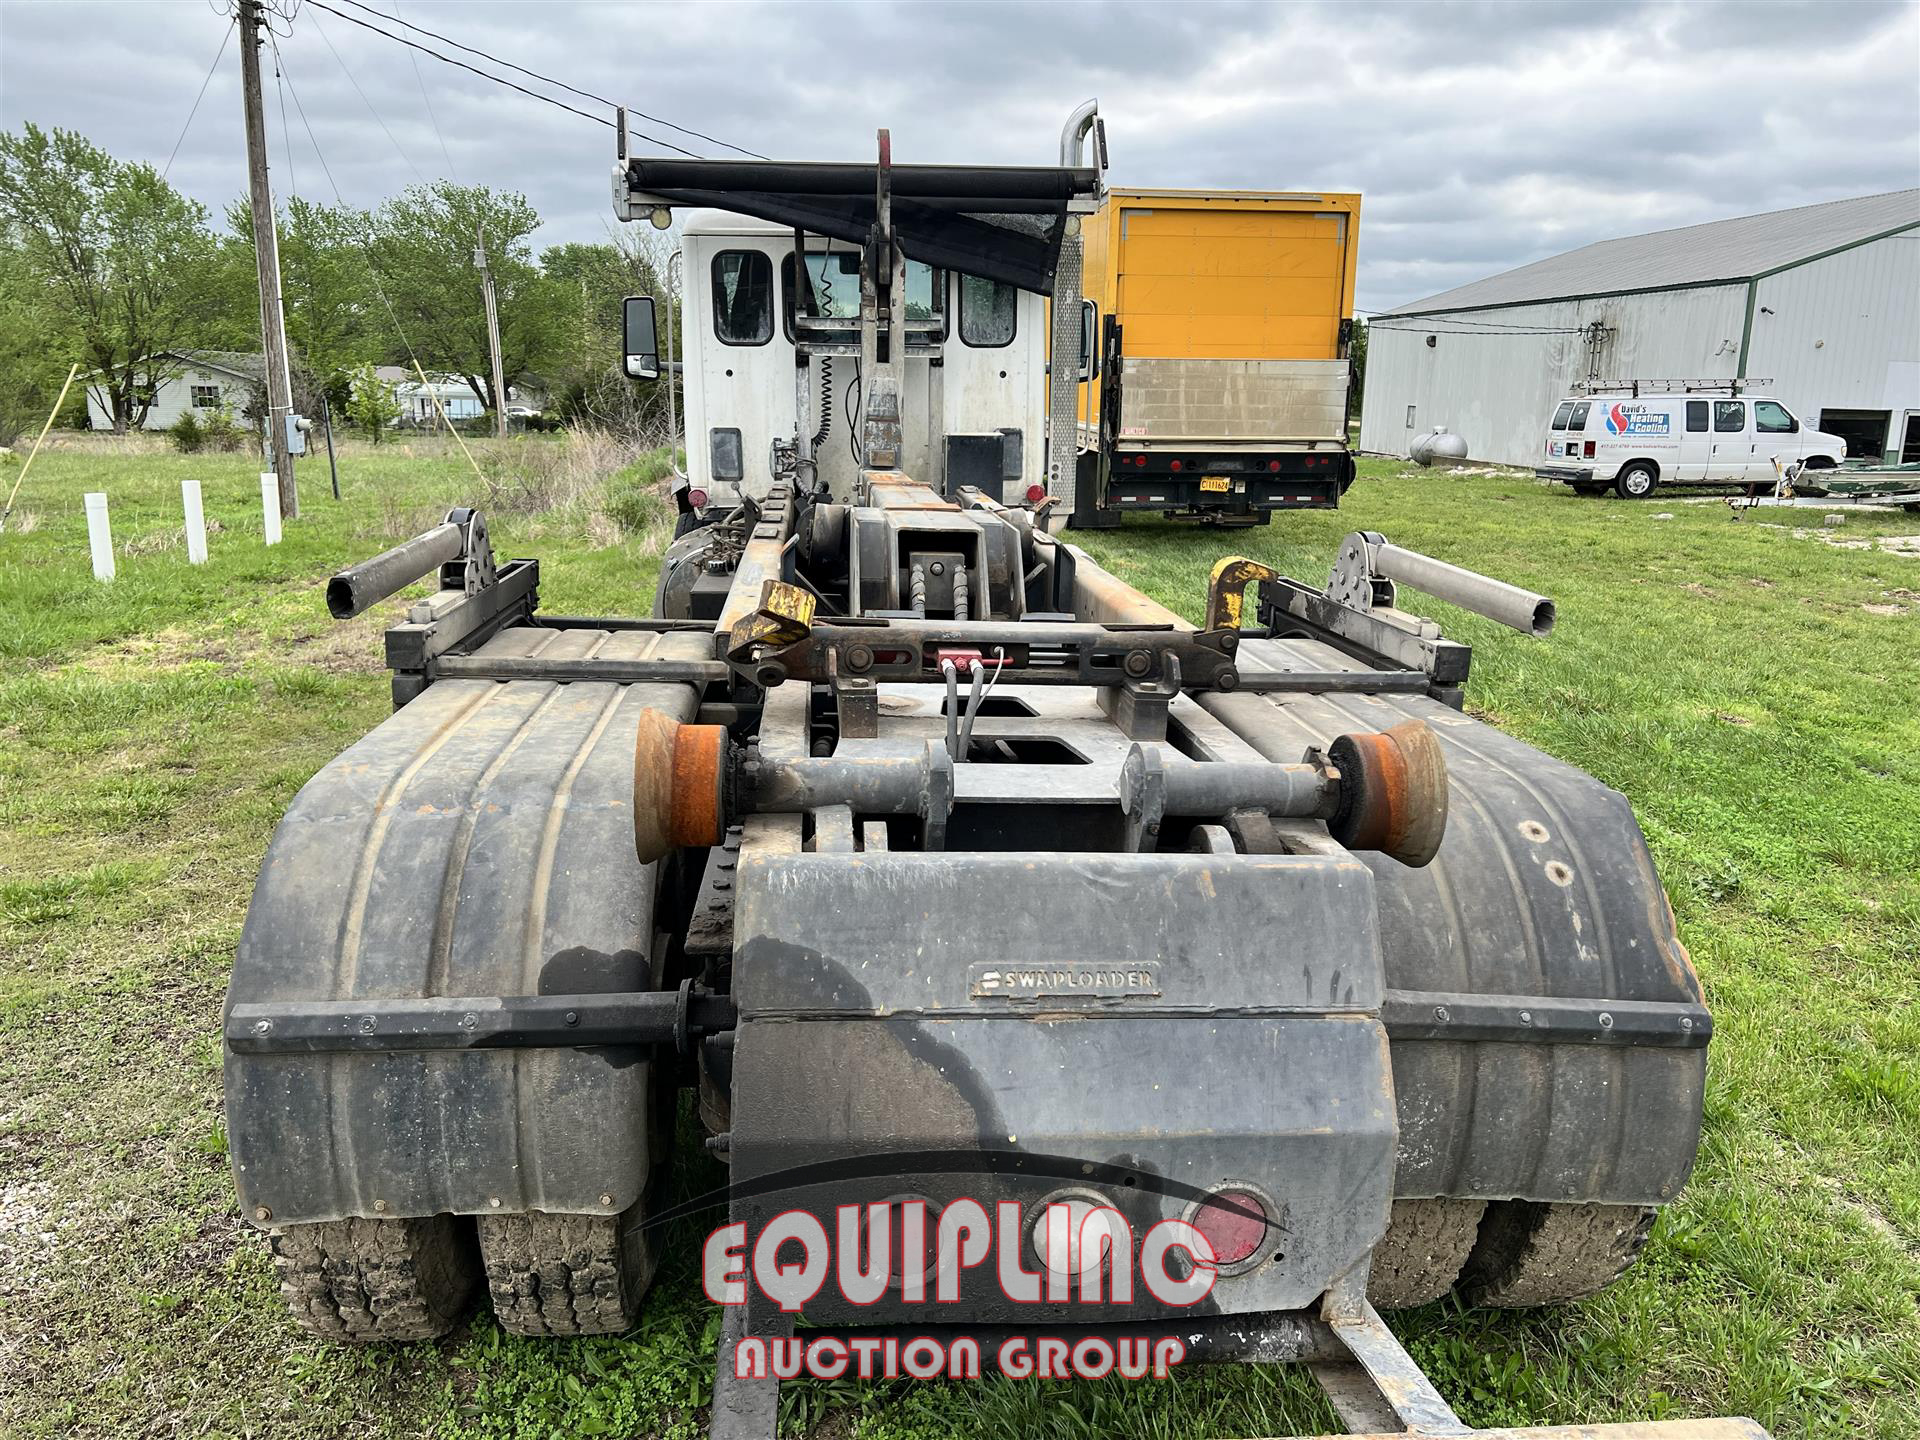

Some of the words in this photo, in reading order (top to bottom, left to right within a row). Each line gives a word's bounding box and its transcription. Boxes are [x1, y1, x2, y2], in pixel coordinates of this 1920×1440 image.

[1621, 404, 1647, 413] David's
[1629, 413, 1664, 424] Heating
[1634, 423, 1669, 433] Cooling
[1006, 970, 1153, 989] SWAPLOADER
